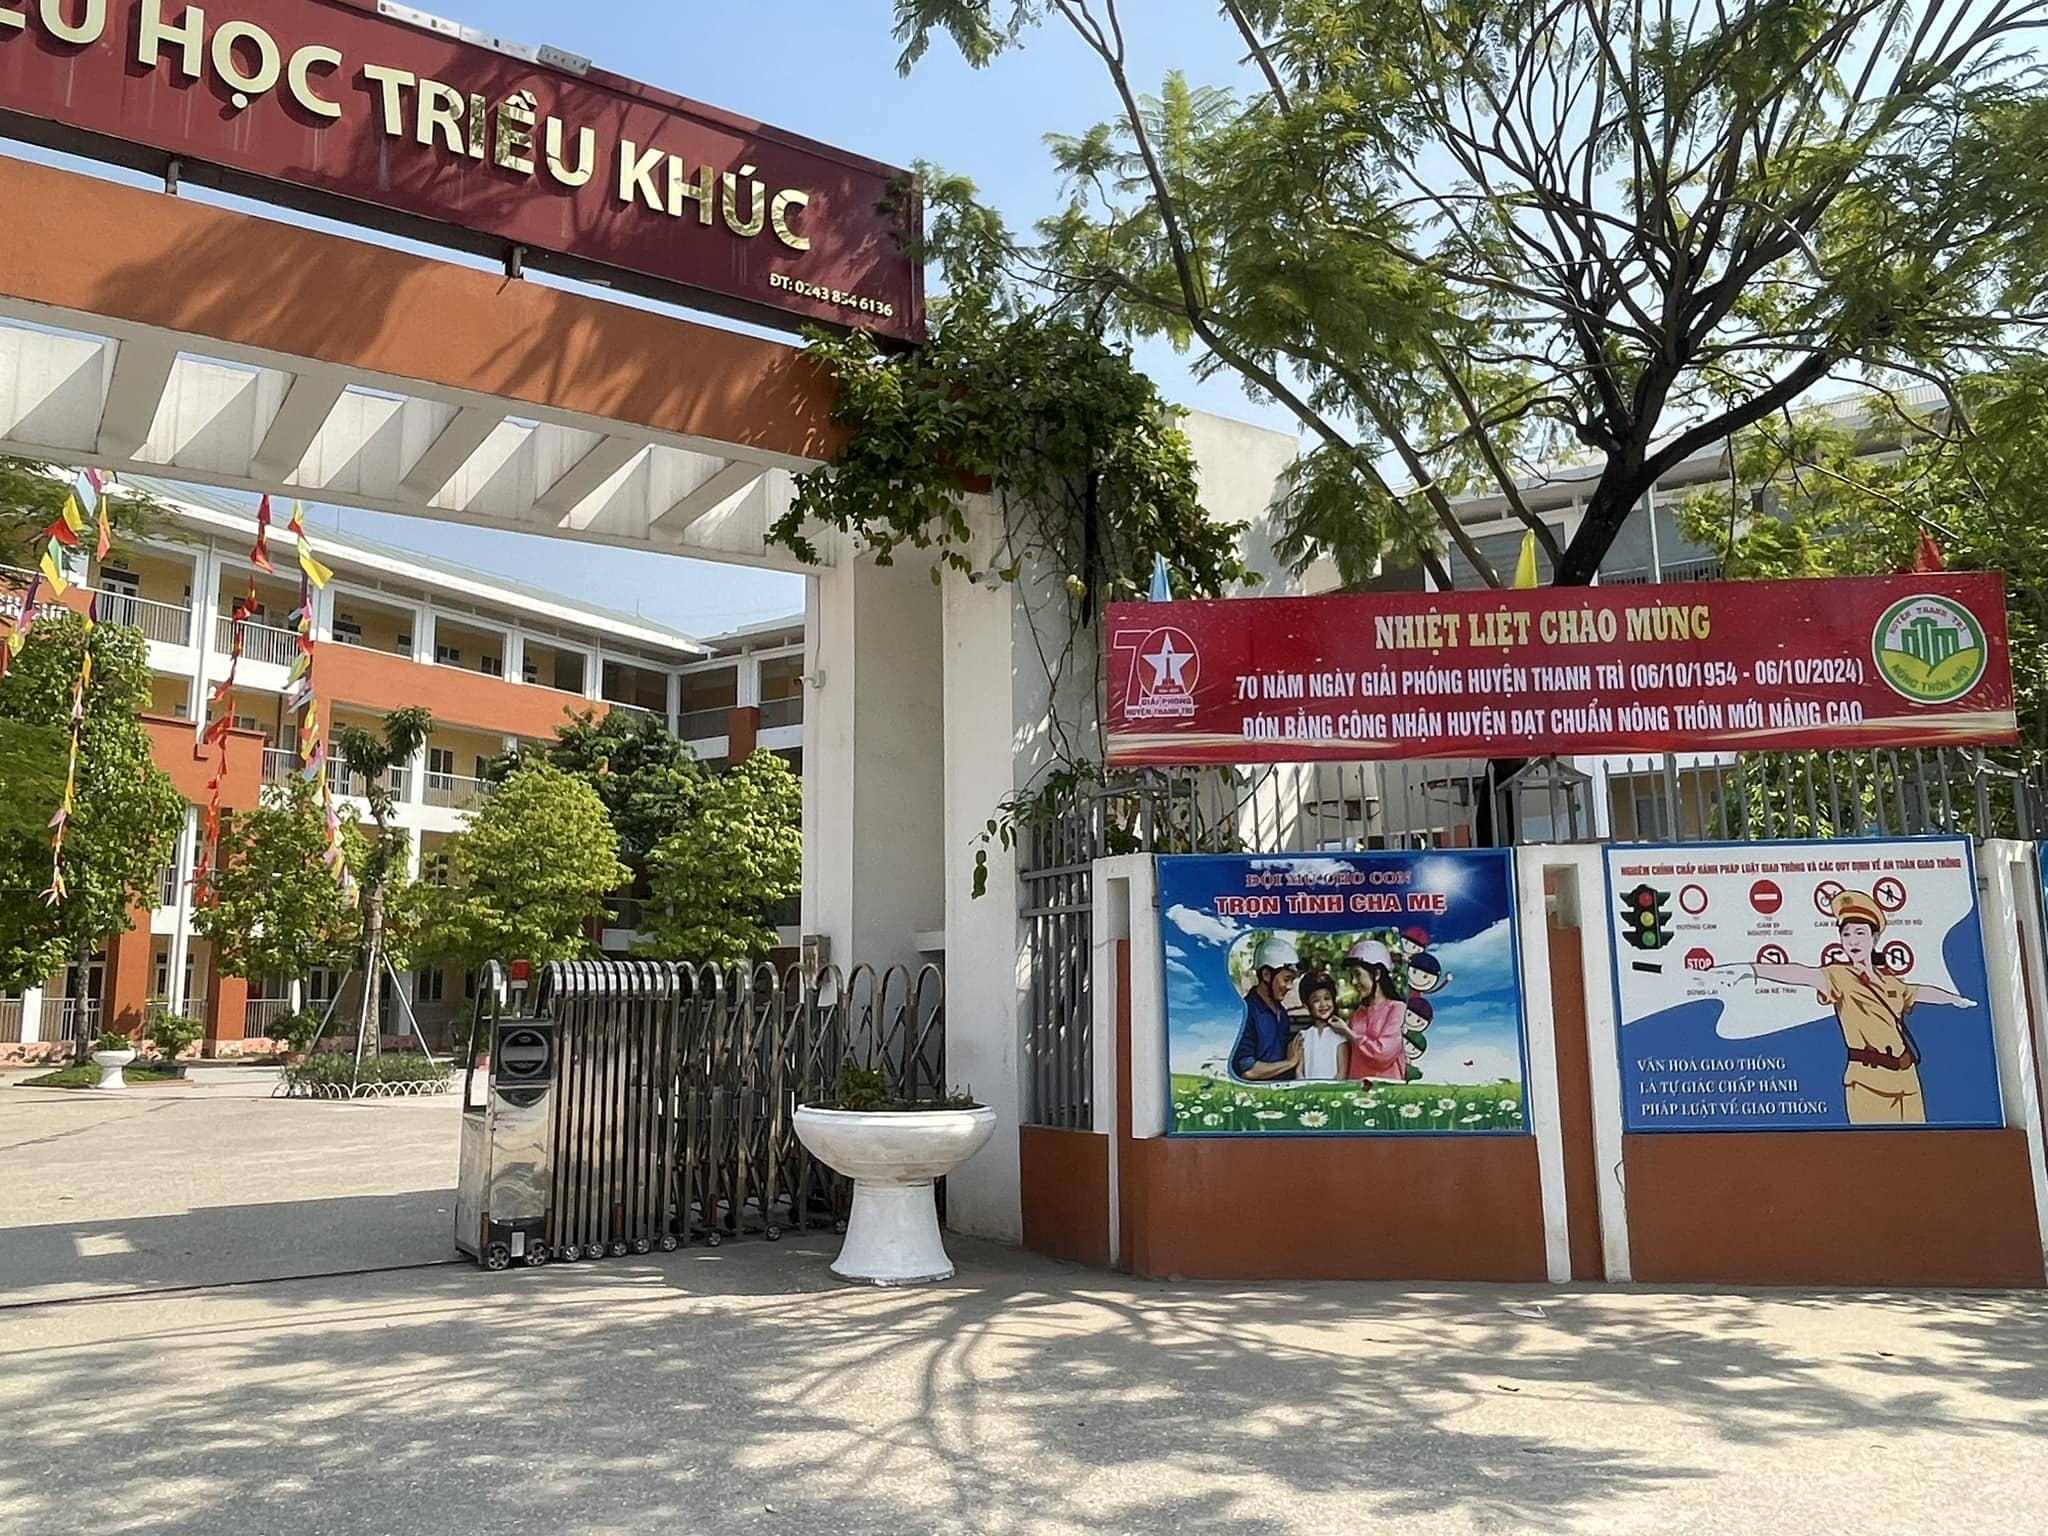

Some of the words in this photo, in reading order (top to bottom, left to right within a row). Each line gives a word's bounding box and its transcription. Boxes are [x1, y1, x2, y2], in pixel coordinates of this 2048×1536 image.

[138, 0, 343, 118] HỌC
[619, 139, 811, 251] KHÚC
[769, 273, 793, 290] ĐT:
[795, 280, 829, 300] 0243
[831, 290, 857, 308] 854
[859, 297, 893, 317] 6136
[1374, 606, 1460, 655] NHIỆT
[1468, 604, 1531, 654] LIỆT
[1539, 601, 1617, 644] CHÀO
[1625, 599, 1711, 641] MỪNG
[1236, 676, 1258, 700] 70
[1263, 669, 1303, 699] NĂM
[1309, 667, 1355, 698] NGÀY
[1361, 664, 1397, 696] GIẢI
[1402, 665, 1463, 695] PHÓNG
[1468, 663, 1527, 698] HUYỆN
[1531, 665, 1591, 691] THANH
[1596, 659, 1624, 690] TRÌ
[1631, 661, 1738, 692] (06/10/1954
[1755, 657, 1864, 686] 06/10/2024)
[1243, 712, 1279, 740] ĐÓN
[1285, 707, 1333, 739] BẰNG
[1338, 709, 1386, 739] CÔNG
[1392, 707, 1442, 742] NHẬN
[1447, 706, 1506, 741] HUYỆN
[1511, 709, 1545, 740] ĐẠT
[1551, 698, 1613, 734] CHUẨN
[1618, 702, 1669, 732] NÔNG
[1674, 700, 1723, 730] THÔN
[1728, 698, 1763, 729] MỚI
[1769, 697, 1821, 728] NÂNG
[1826, 700, 1864, 727] CAO
[1245, 870, 1283, 890] ĐỘI
[1369, 870, 1412, 885] CON
[1214, 895, 1280, 918] TRỌN
[1285, 892, 1344, 914] TÌNH
[1350, 892, 1401, 913] CHA
[1407, 892, 1447, 916] MẸ
[1686, 958, 1712, 970] STOP
[1700, 1058, 1734, 1071] GIAO
[1660, 1079, 1680, 1096] TỰ
[1742, 1101, 1776, 1114] GIAO
